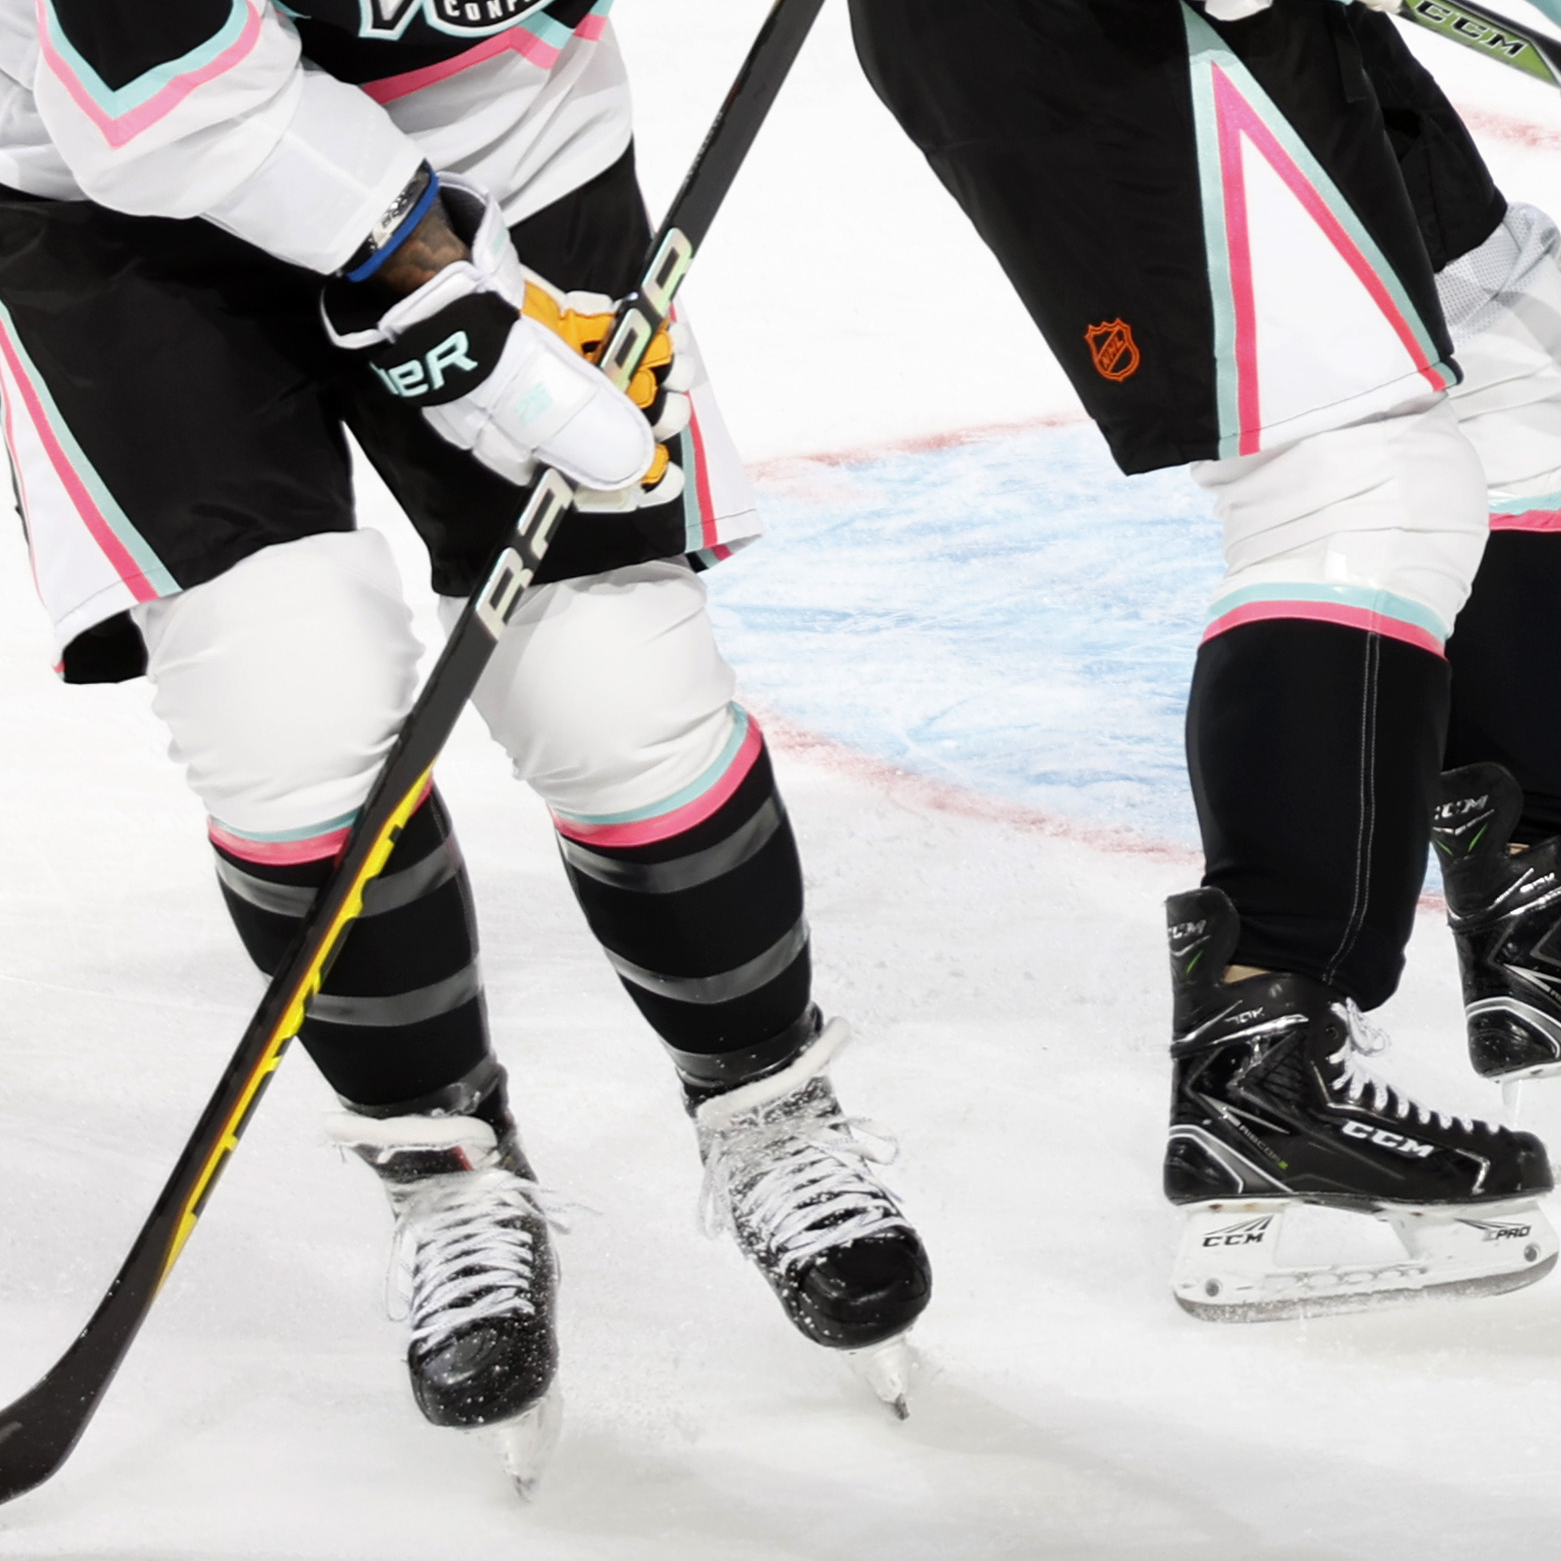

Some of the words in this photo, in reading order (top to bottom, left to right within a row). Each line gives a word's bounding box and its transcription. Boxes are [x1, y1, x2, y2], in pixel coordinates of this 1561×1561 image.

[474, 227, 693, 642] BAER
[1342, 1120, 1435, 1158] CCM
[1202, 1231, 1265, 1248] CCM
